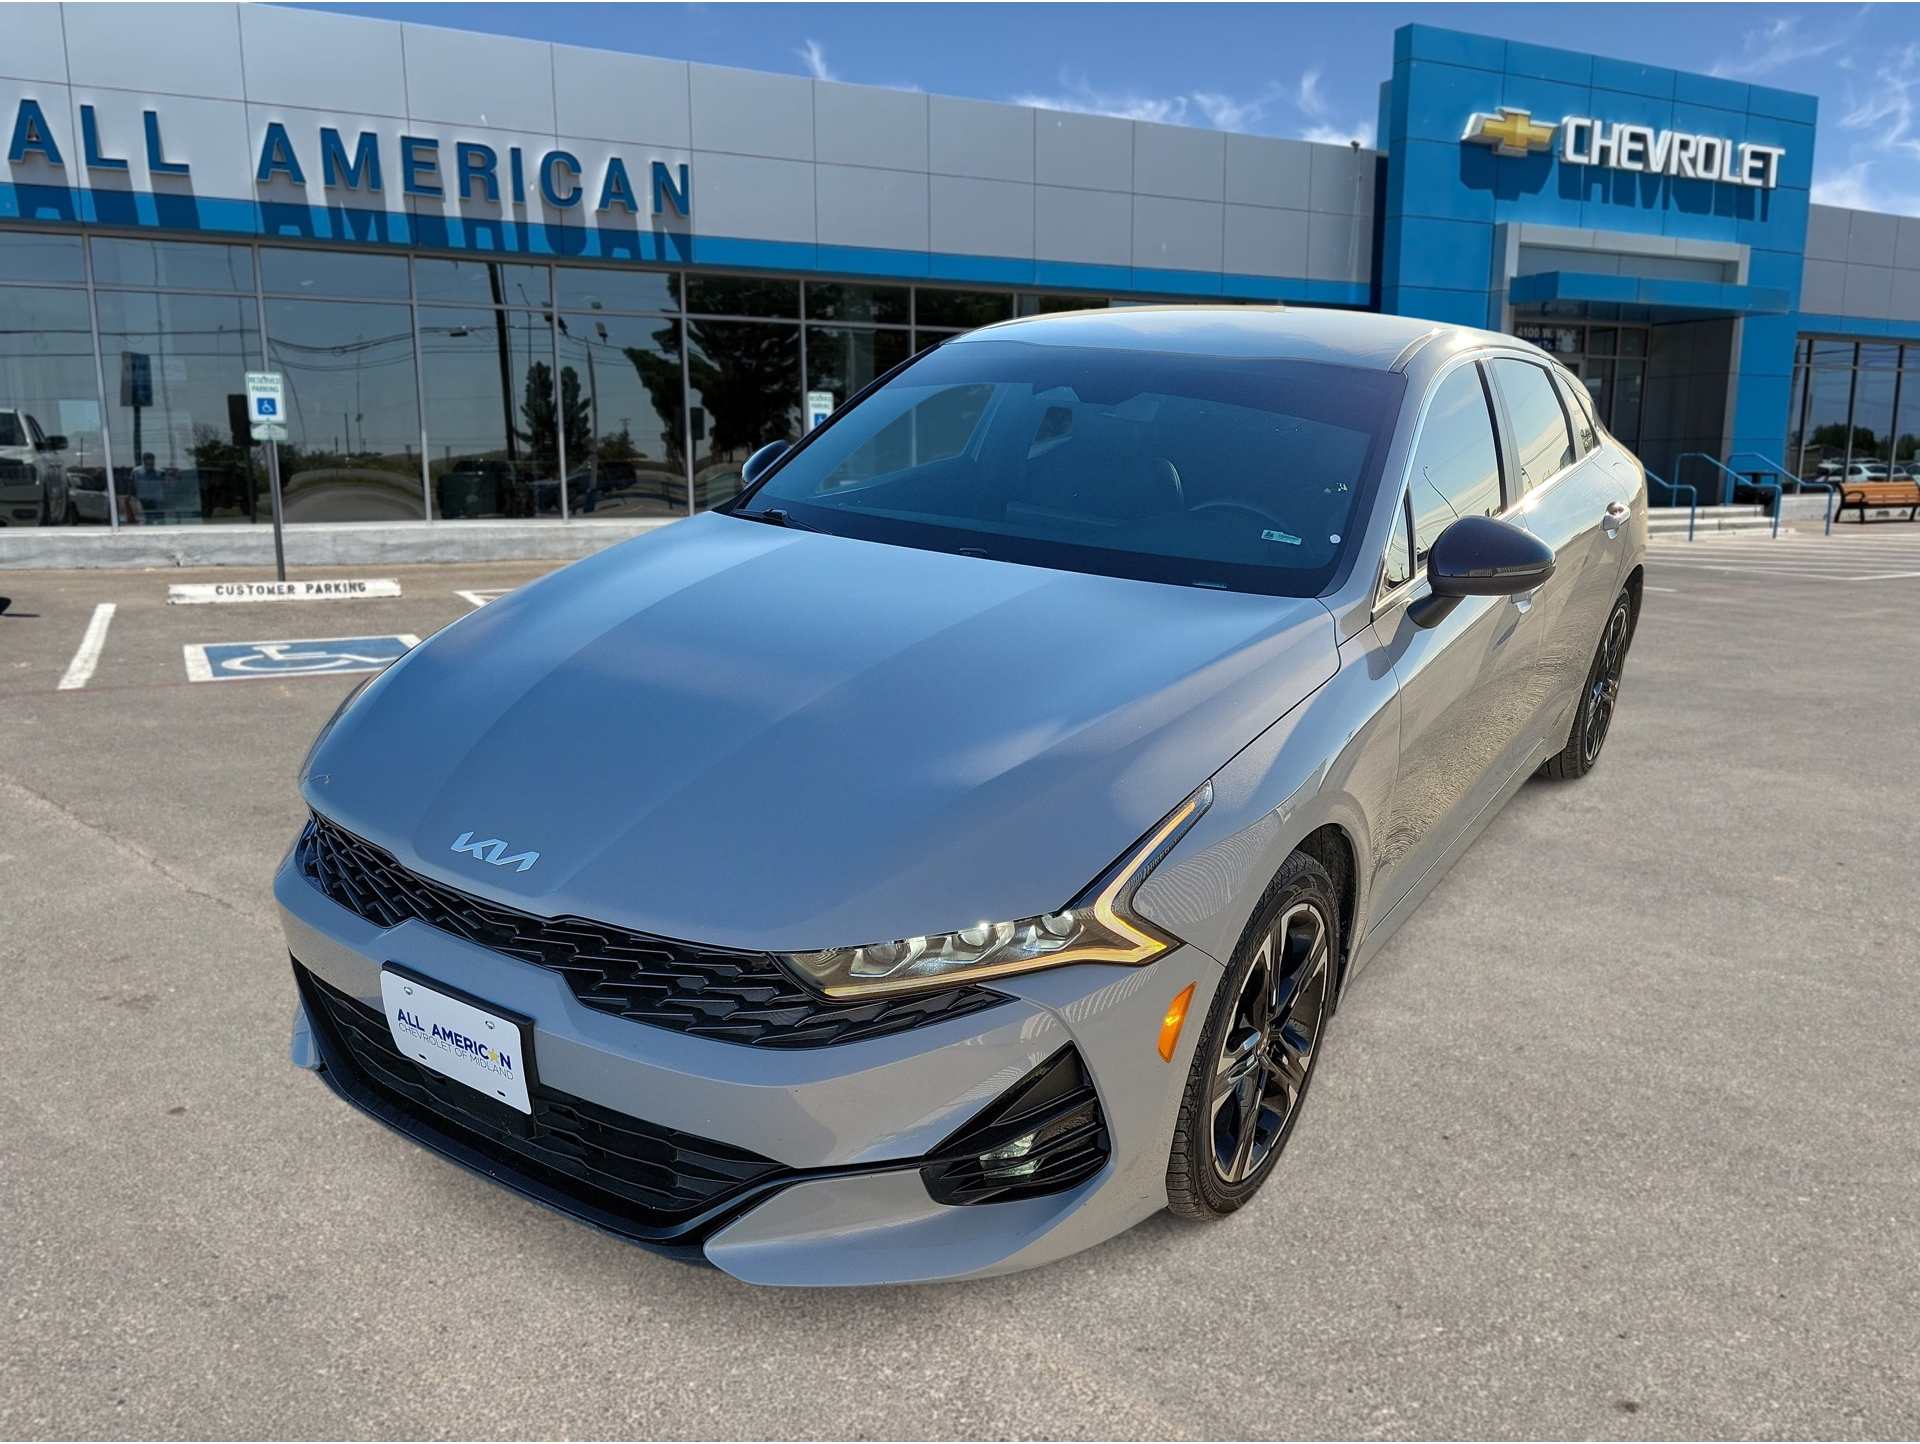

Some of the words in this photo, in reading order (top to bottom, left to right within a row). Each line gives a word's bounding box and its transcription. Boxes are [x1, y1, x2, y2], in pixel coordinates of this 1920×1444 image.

[8, 98, 191, 175] ALL
[256, 121, 691, 217] AMERICAN
[1561, 114, 1786, 188] CHEVROLET
[215, 584, 296, 596] CUSTOMER
[305, 581, 367, 595] PARKING
[397, 1008, 425, 1033] ALL
[431, 1024, 512, 1070] AMERICN
[398, 1022, 452, 1053] CHEVROLET
[454, 1046, 468, 1060] OF
[469, 1054, 514, 1081] MIDLAND
